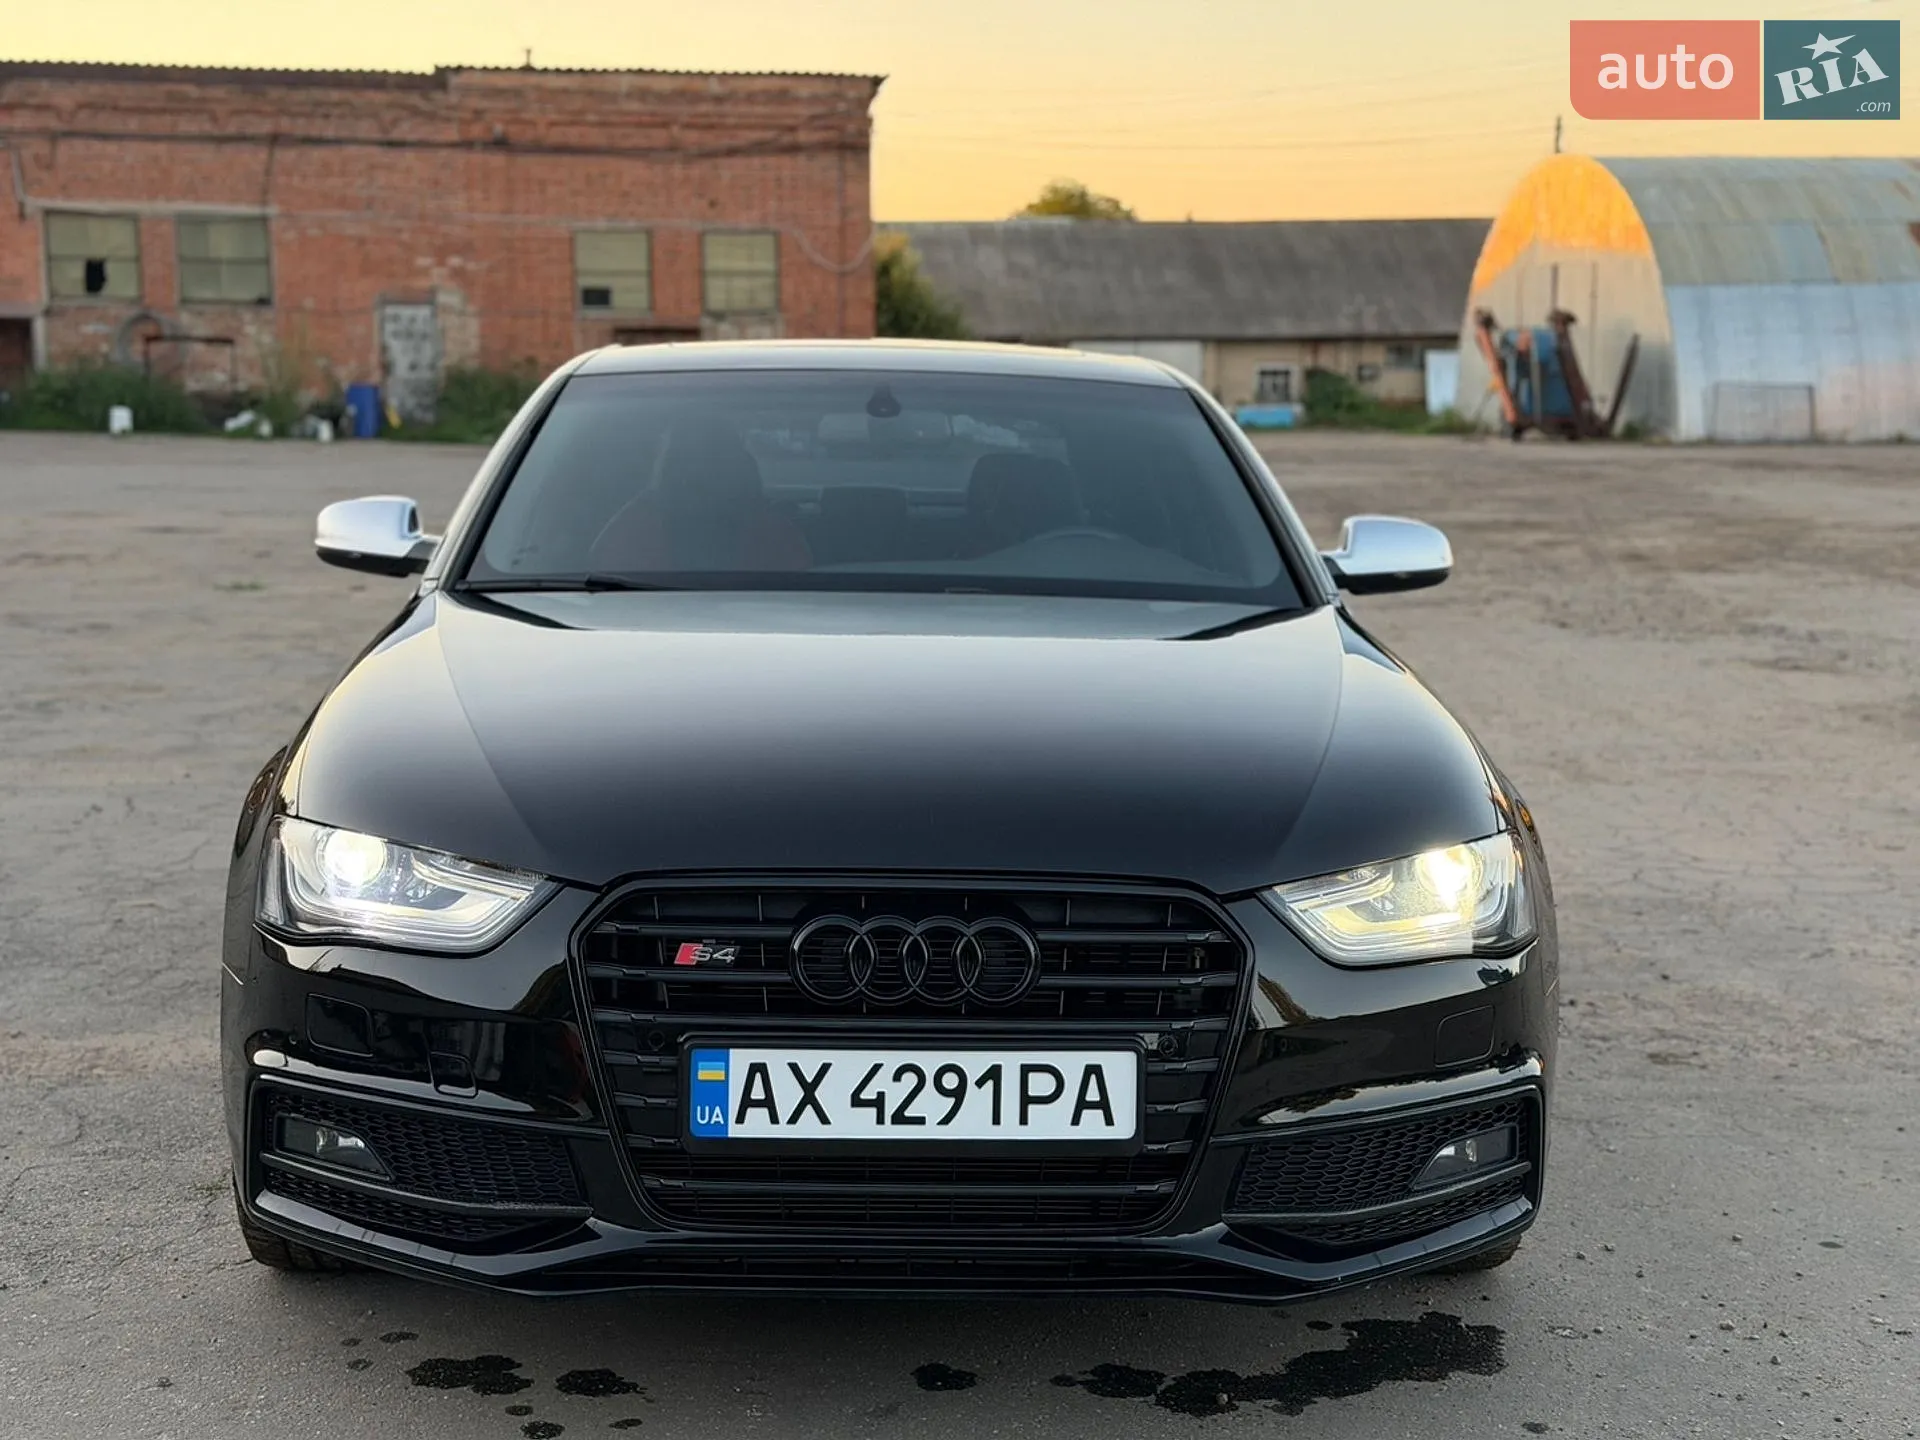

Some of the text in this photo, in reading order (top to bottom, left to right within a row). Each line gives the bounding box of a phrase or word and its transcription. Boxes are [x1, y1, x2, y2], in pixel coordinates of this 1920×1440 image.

[690, 946, 735, 963] S4
[734, 1062, 833, 1125] AX
[696, 1105, 724, 1125] UA
